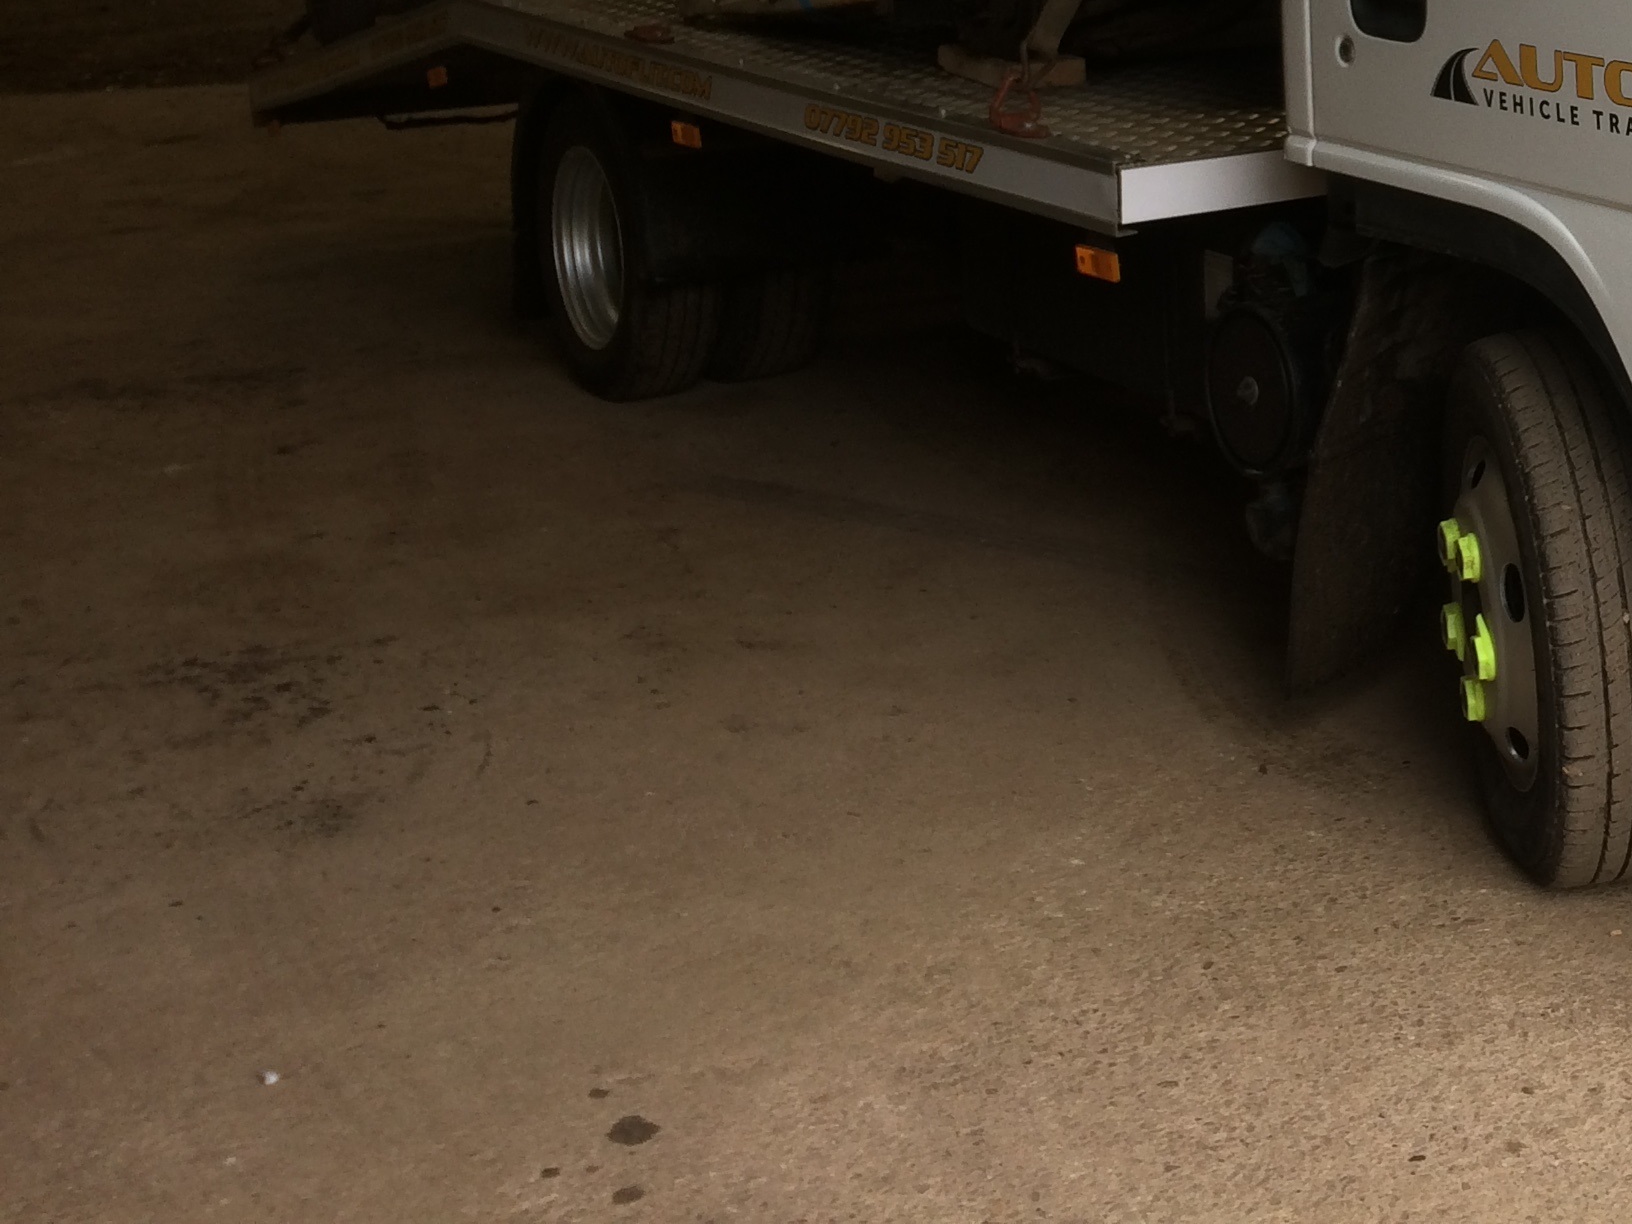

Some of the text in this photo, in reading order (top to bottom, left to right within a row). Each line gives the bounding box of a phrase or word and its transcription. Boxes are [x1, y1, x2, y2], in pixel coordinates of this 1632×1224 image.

[1483, 88, 1580, 127] VEHICLE
[803, 103, 984, 174] 07792 953 517
